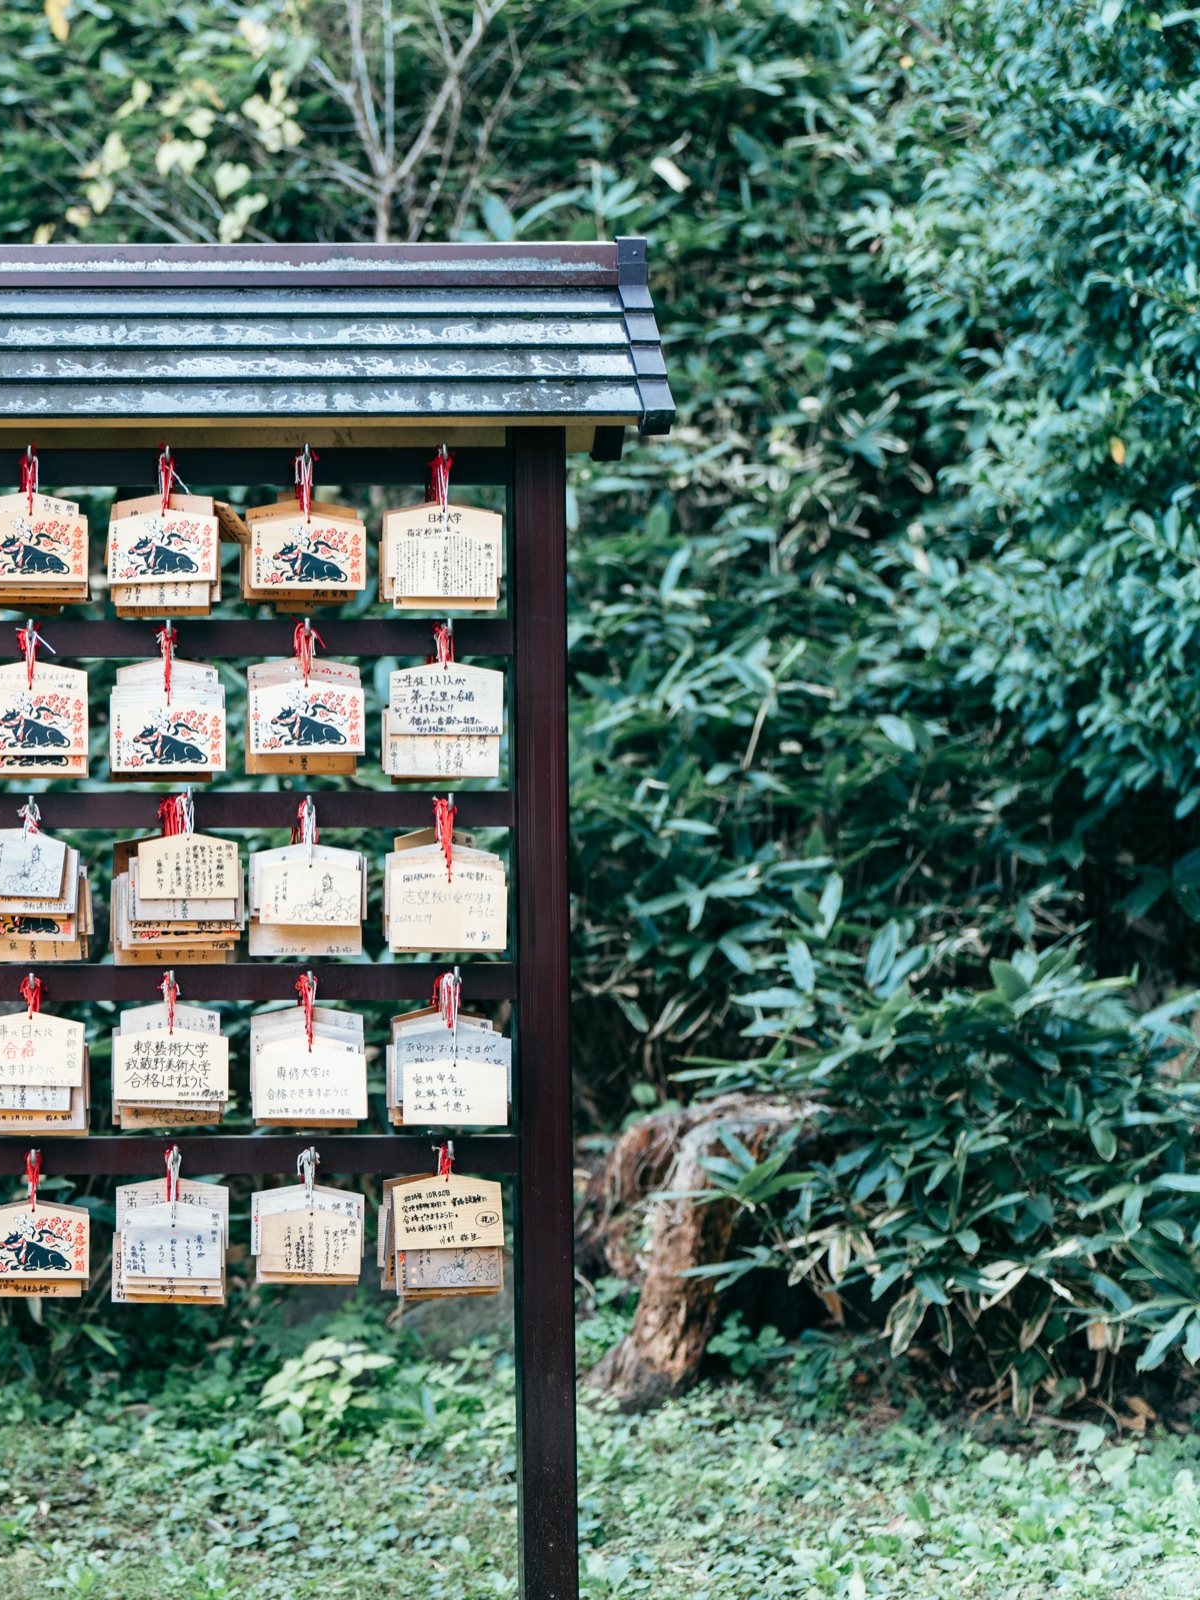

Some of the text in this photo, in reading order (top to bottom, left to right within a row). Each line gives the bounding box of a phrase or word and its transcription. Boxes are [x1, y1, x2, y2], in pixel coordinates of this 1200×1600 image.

[428, 513, 462, 524] 日本大学
[3, 1039, 36, 1060] 合格
[132, 1039, 210, 1058] 東京藝術大学
[124, 1056, 212, 1076] 武蔵野美術大学
[276, 1066, 331, 1081] 専修大学に
[123, 1071, 211, 1089] 合格しますように
[265, 1087, 351, 1101] 合格できますように
[123, 1190, 209, 1208] 第一志校に
[74, 1222, 86, 1272] 合格祈願
